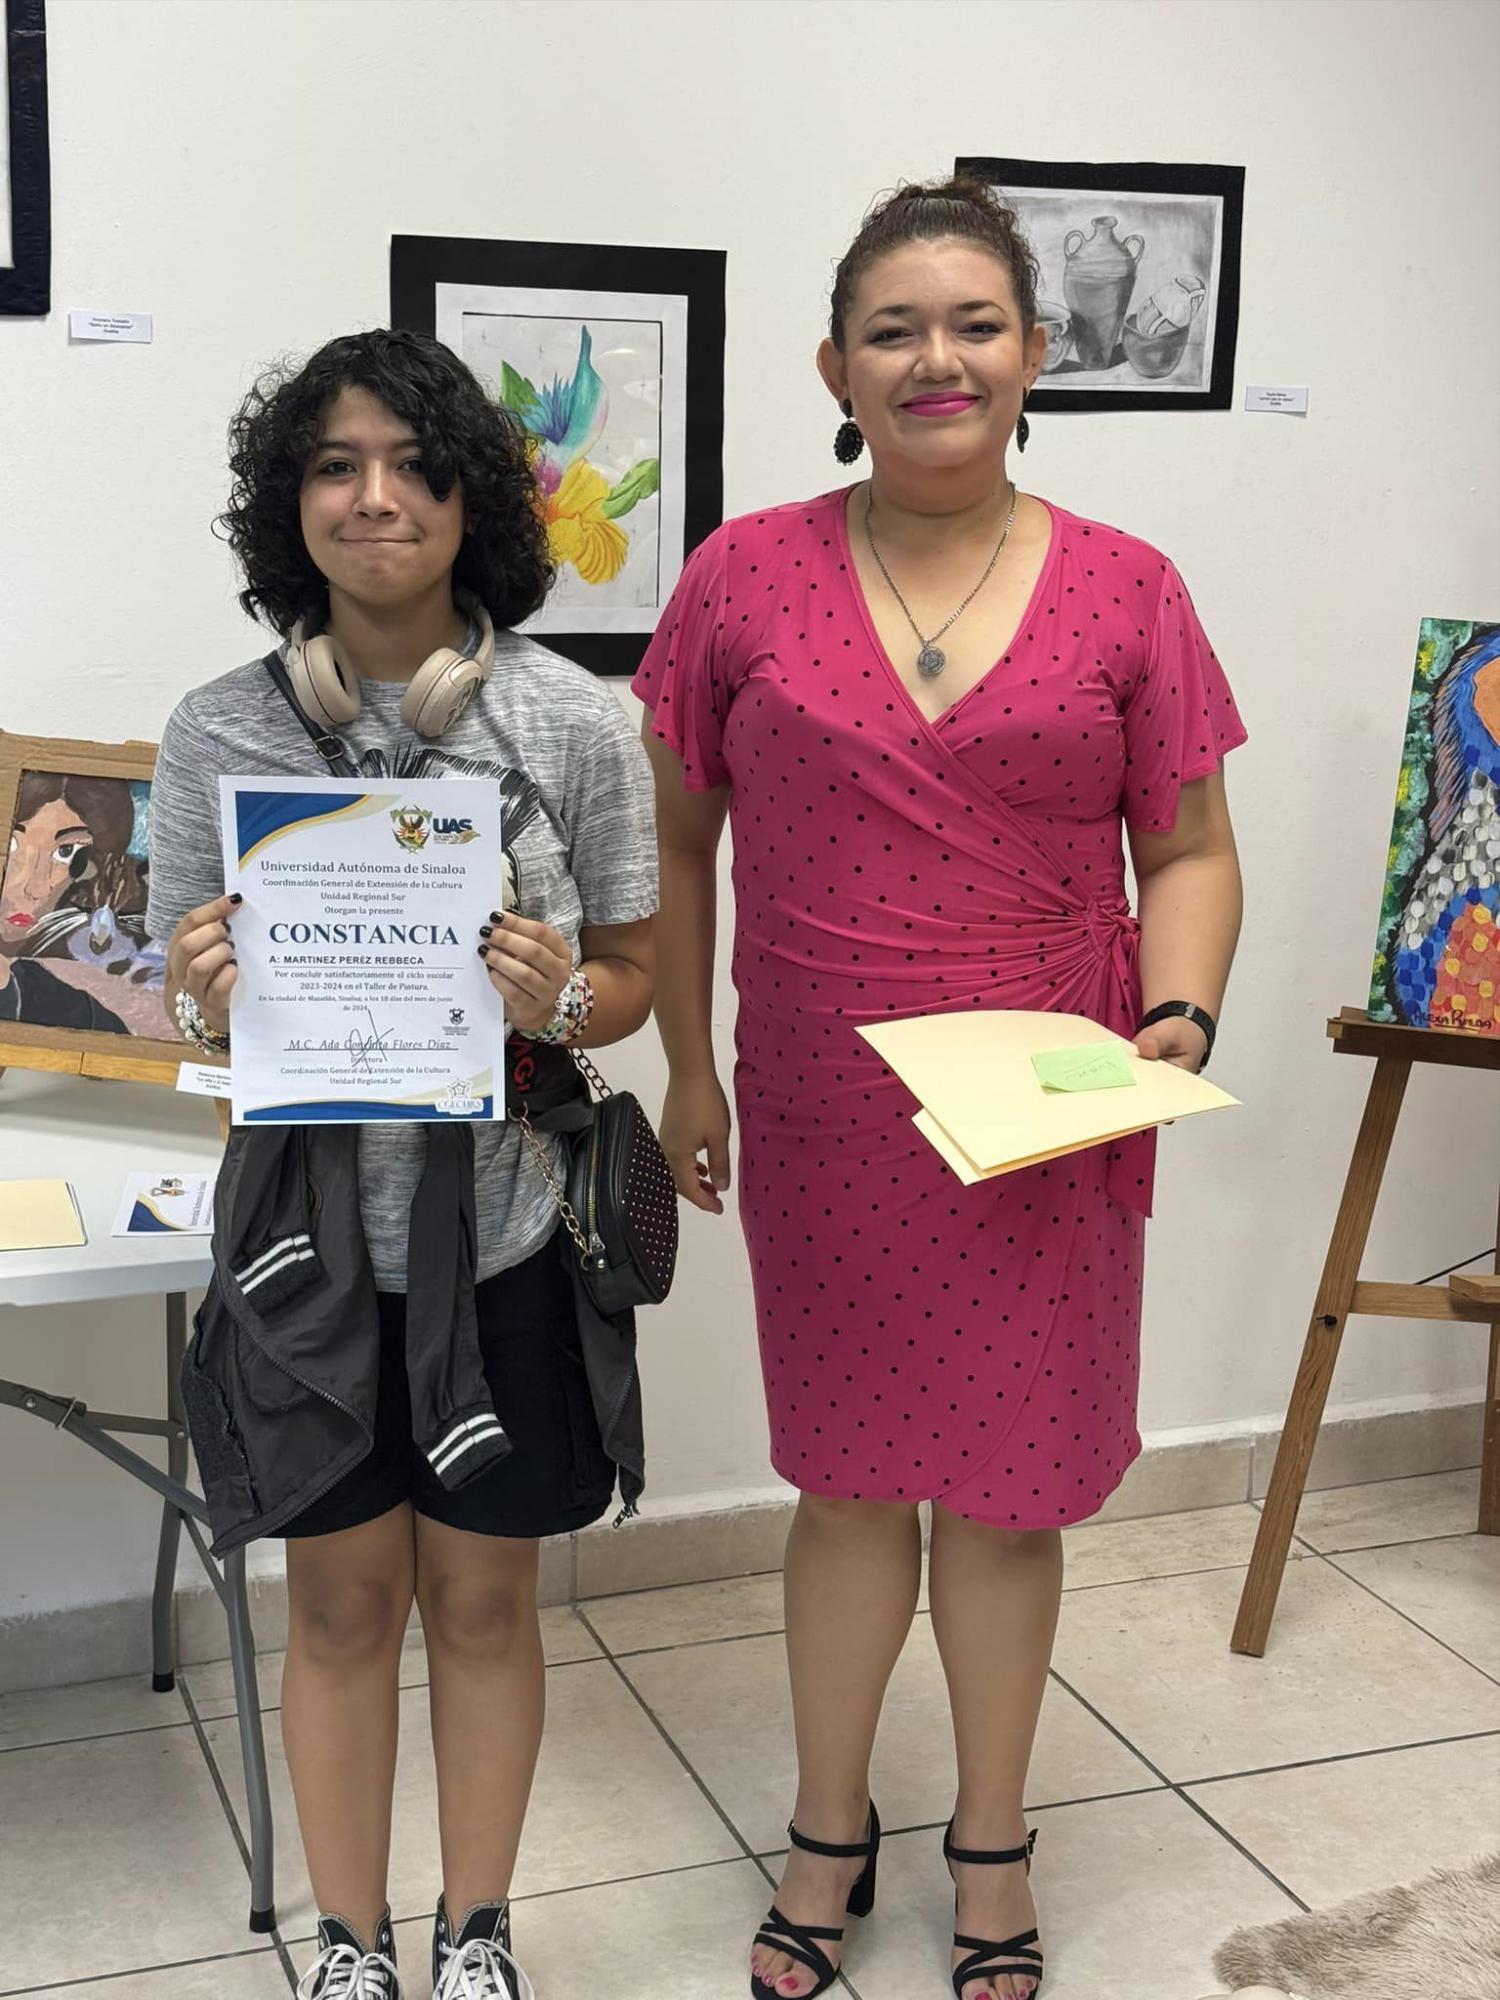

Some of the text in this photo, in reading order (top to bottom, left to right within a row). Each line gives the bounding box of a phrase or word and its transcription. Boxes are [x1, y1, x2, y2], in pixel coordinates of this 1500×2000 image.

[433, 818, 472, 834] UAS
[261, 860, 466, 875] Universidad Autónoma de Sinaloa
[262, 878, 463, 890] Coordinación General de Extensión de la Cultura
[320, 892, 406, 902] Unidad Regional Sur
[324, 905, 405, 916] Otorgan la presente
[269, 922, 459, 946] CONSTANCIA
[269, 955, 280, 964] A:
[283, 955, 336, 965] MARTINEZ
[374, 956, 425, 965] REBBECA
[274, 970, 454, 980] Por concluir satisfactoriamente el ciclo escolar
[300, 982, 342, 991] 2023-2024
[355, 982, 362, 991] el
[364, 982, 386, 991] Taller
[388, 983, 397, 991] de
[320, 1039, 340, 1050] Ada
[393, 1039, 423, 1050] Flores
